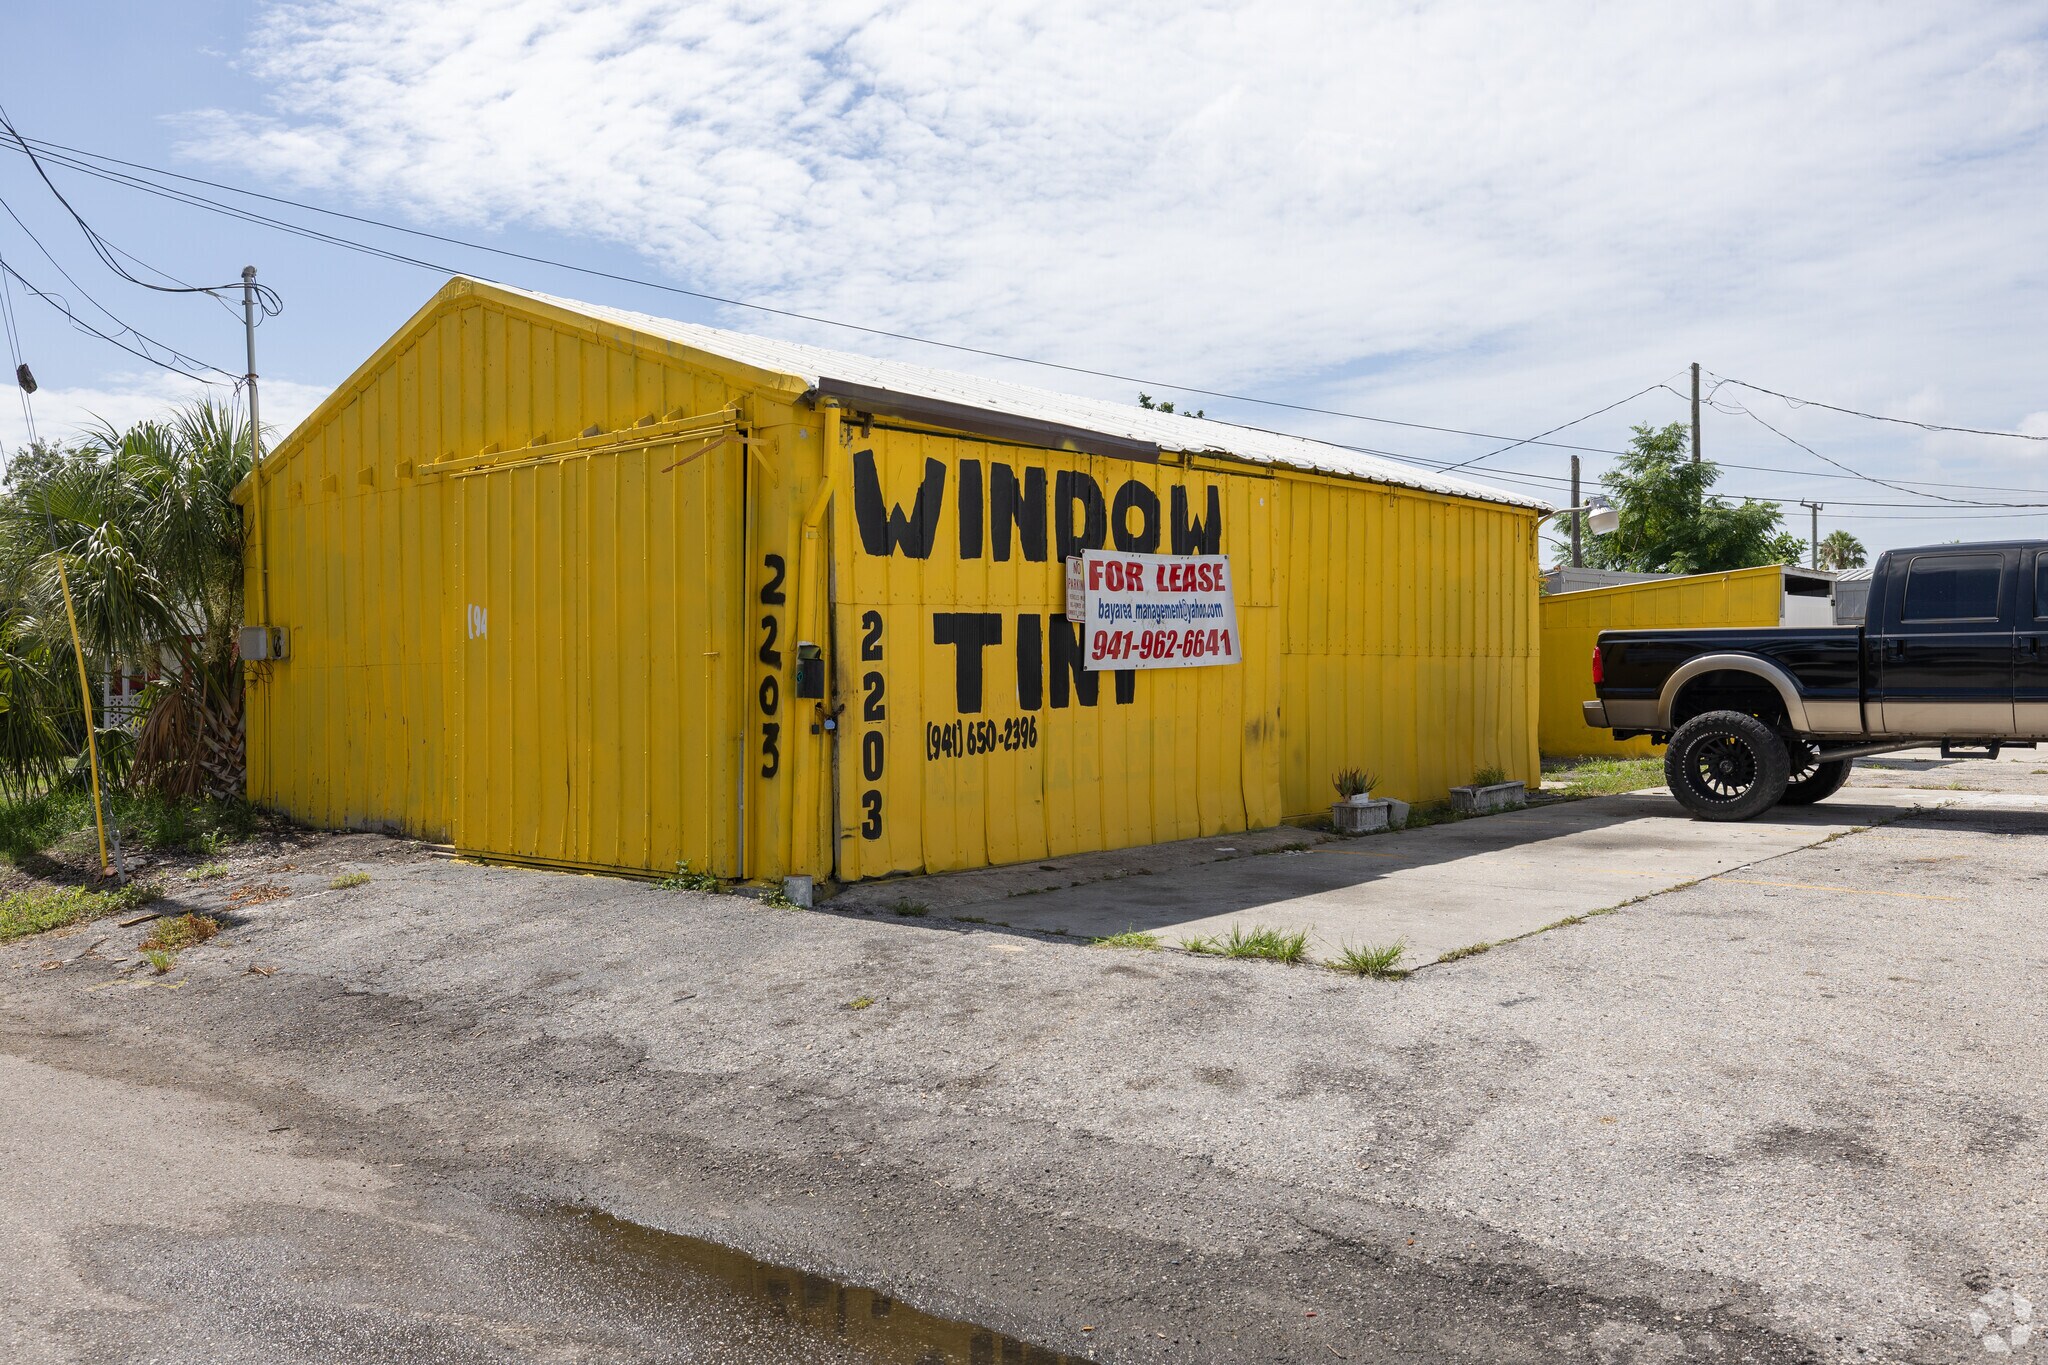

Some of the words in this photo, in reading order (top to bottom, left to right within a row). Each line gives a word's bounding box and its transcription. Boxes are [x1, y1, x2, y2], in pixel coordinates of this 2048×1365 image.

[853, 449, 1222, 564] WINDOW
[1073, 561, 1082, 575] NO
[1089, 560, 1144, 592] FOR
[1156, 563, 1226, 592] LEASE
[1098, 598, 1224, 625] bayarea_management@yahoo.com
[1091, 629, 1232, 661] 941-962-6641
[759, 554, 786, 778] 2203
[861, 610, 886, 840] 2203
